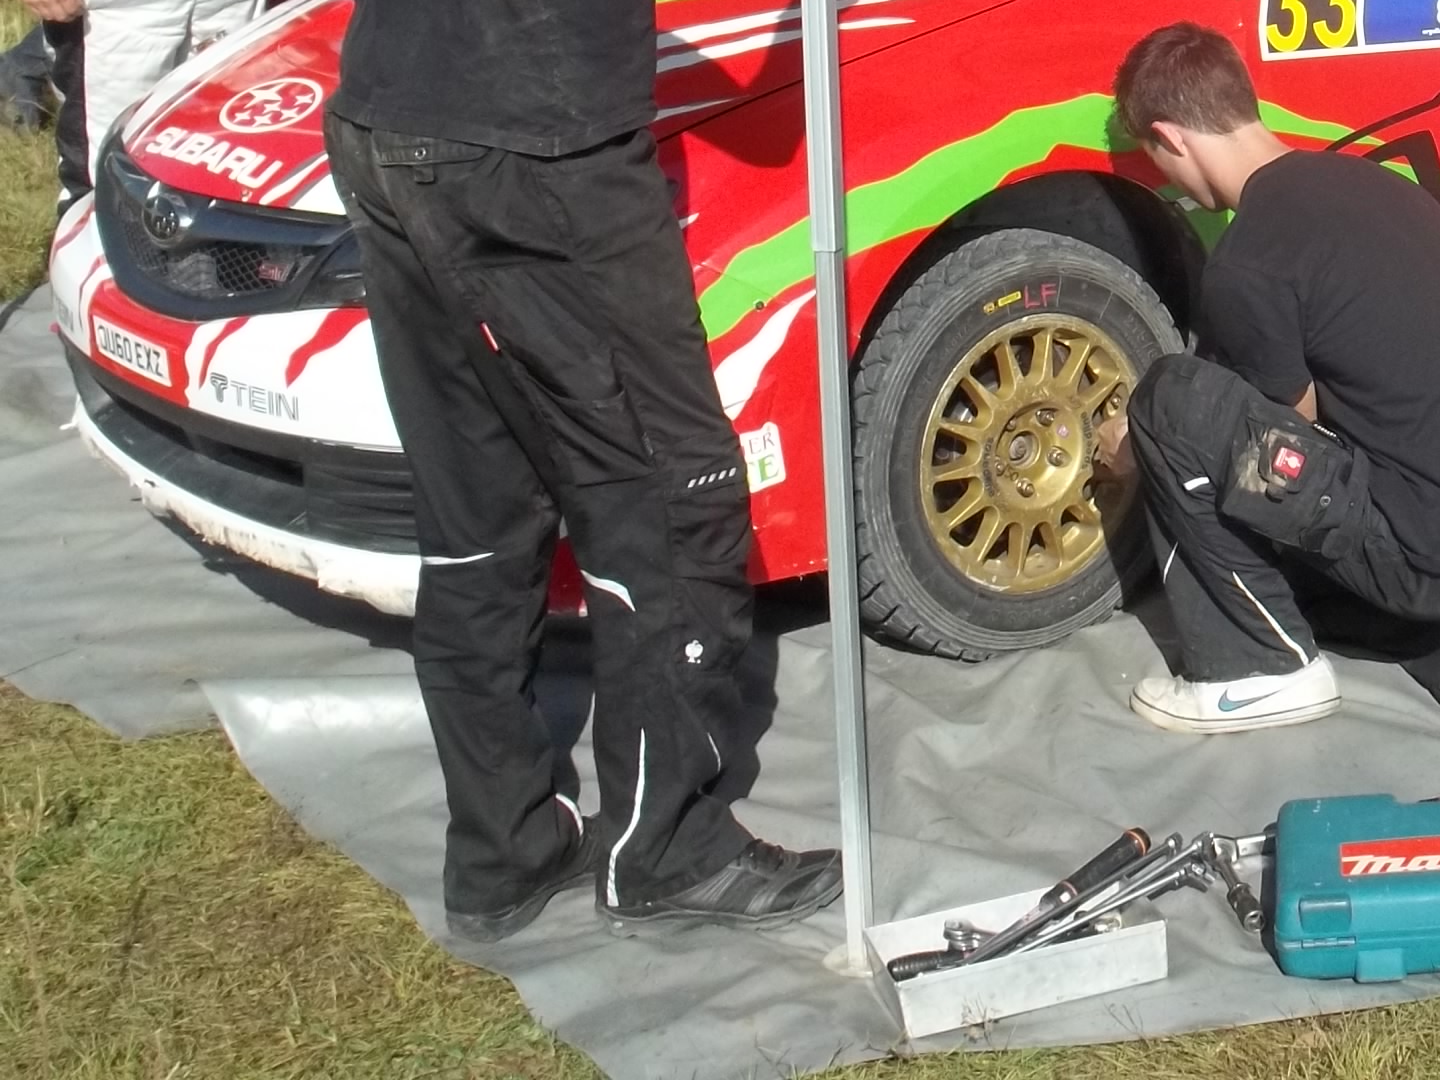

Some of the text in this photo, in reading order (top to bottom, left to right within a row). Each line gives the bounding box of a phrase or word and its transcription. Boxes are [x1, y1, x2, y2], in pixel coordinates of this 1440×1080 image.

[145, 126, 284, 189] SUBARU
[1023, 283, 1057, 310] LF
[135, 341, 164, 378] EXZ
[231, 379, 300, 422] TEIN
